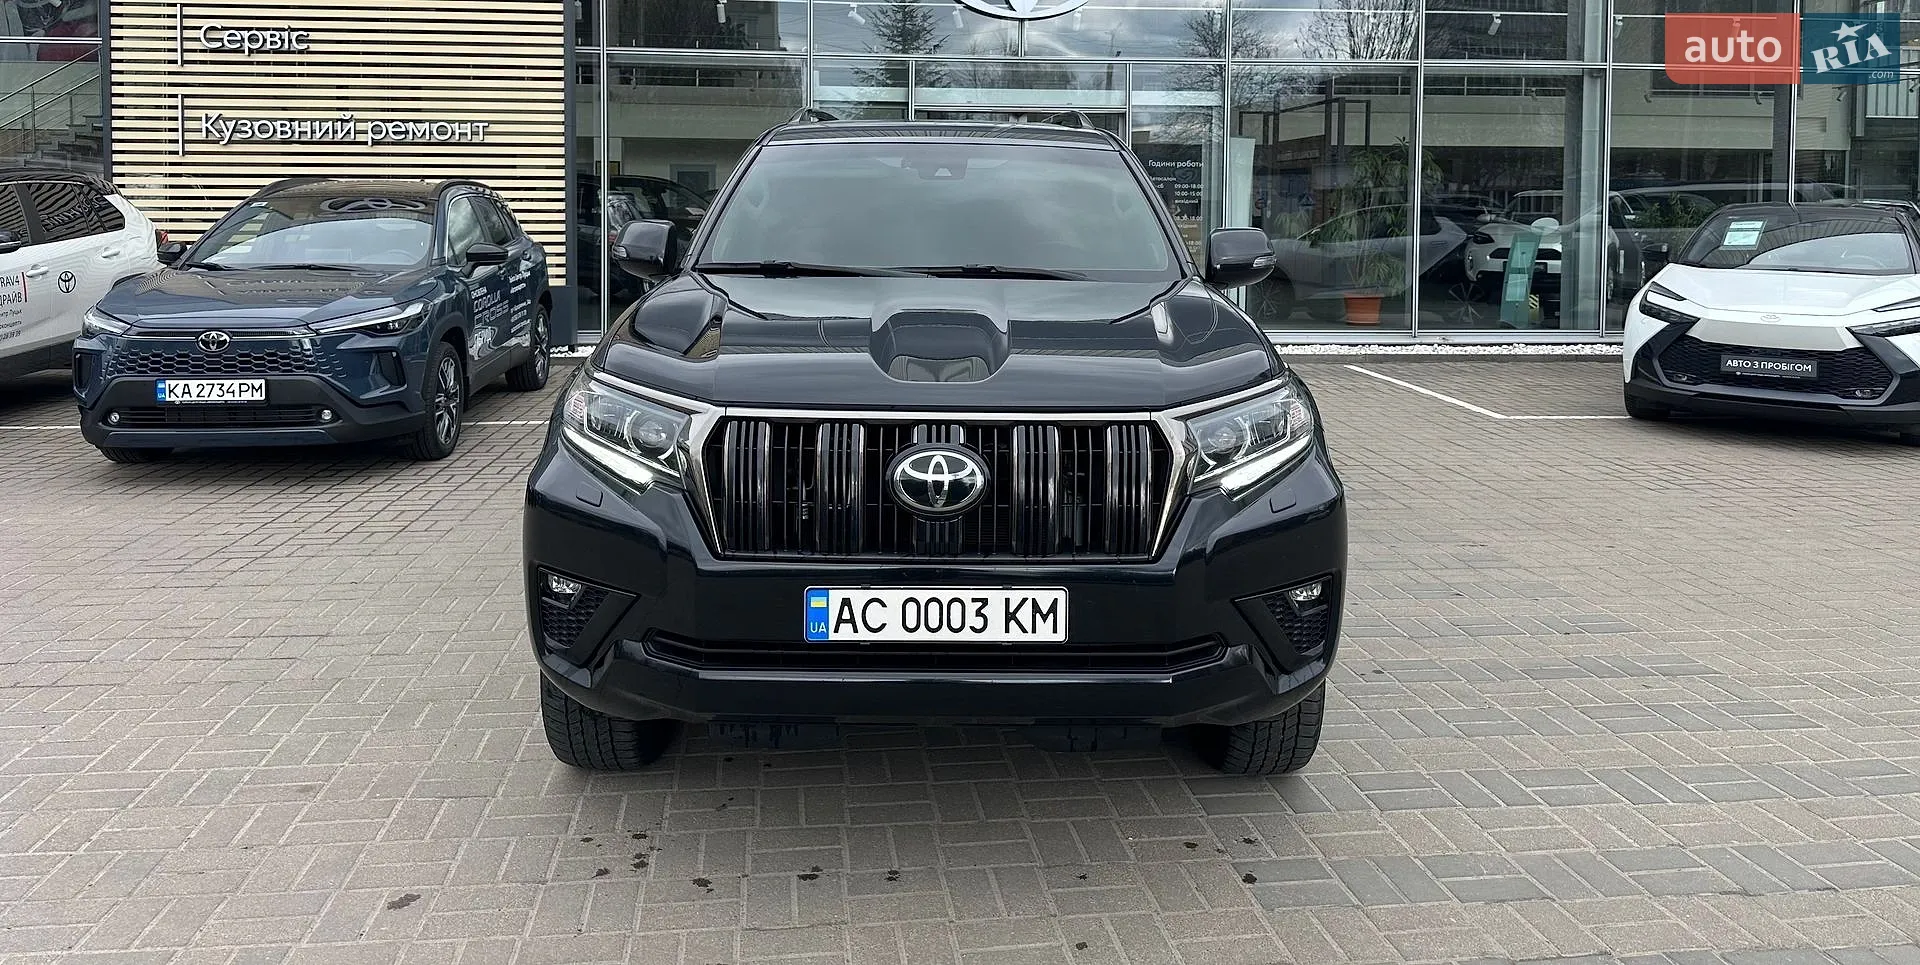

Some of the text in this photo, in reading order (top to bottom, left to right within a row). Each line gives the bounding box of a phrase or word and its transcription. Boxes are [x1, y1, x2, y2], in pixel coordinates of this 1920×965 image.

[200, 23, 309, 55] Сервіс
[201, 112, 489, 146] Кузовний ремонт
[1148, 160, 1204, 168] Години роботи
[0, 275, 20, 288] RAV4
[474, 289, 501, 313] COROLLA
[475, 299, 510, 328] CROSS
[1726, 359, 1752, 368] АВТО
[1760, 361, 1812, 372] ПРОБІГОМ
[196, 383, 235, 398] 2734
[833, 596, 1058, 634] AC 0003 KM
[810, 621, 827, 633] UA
